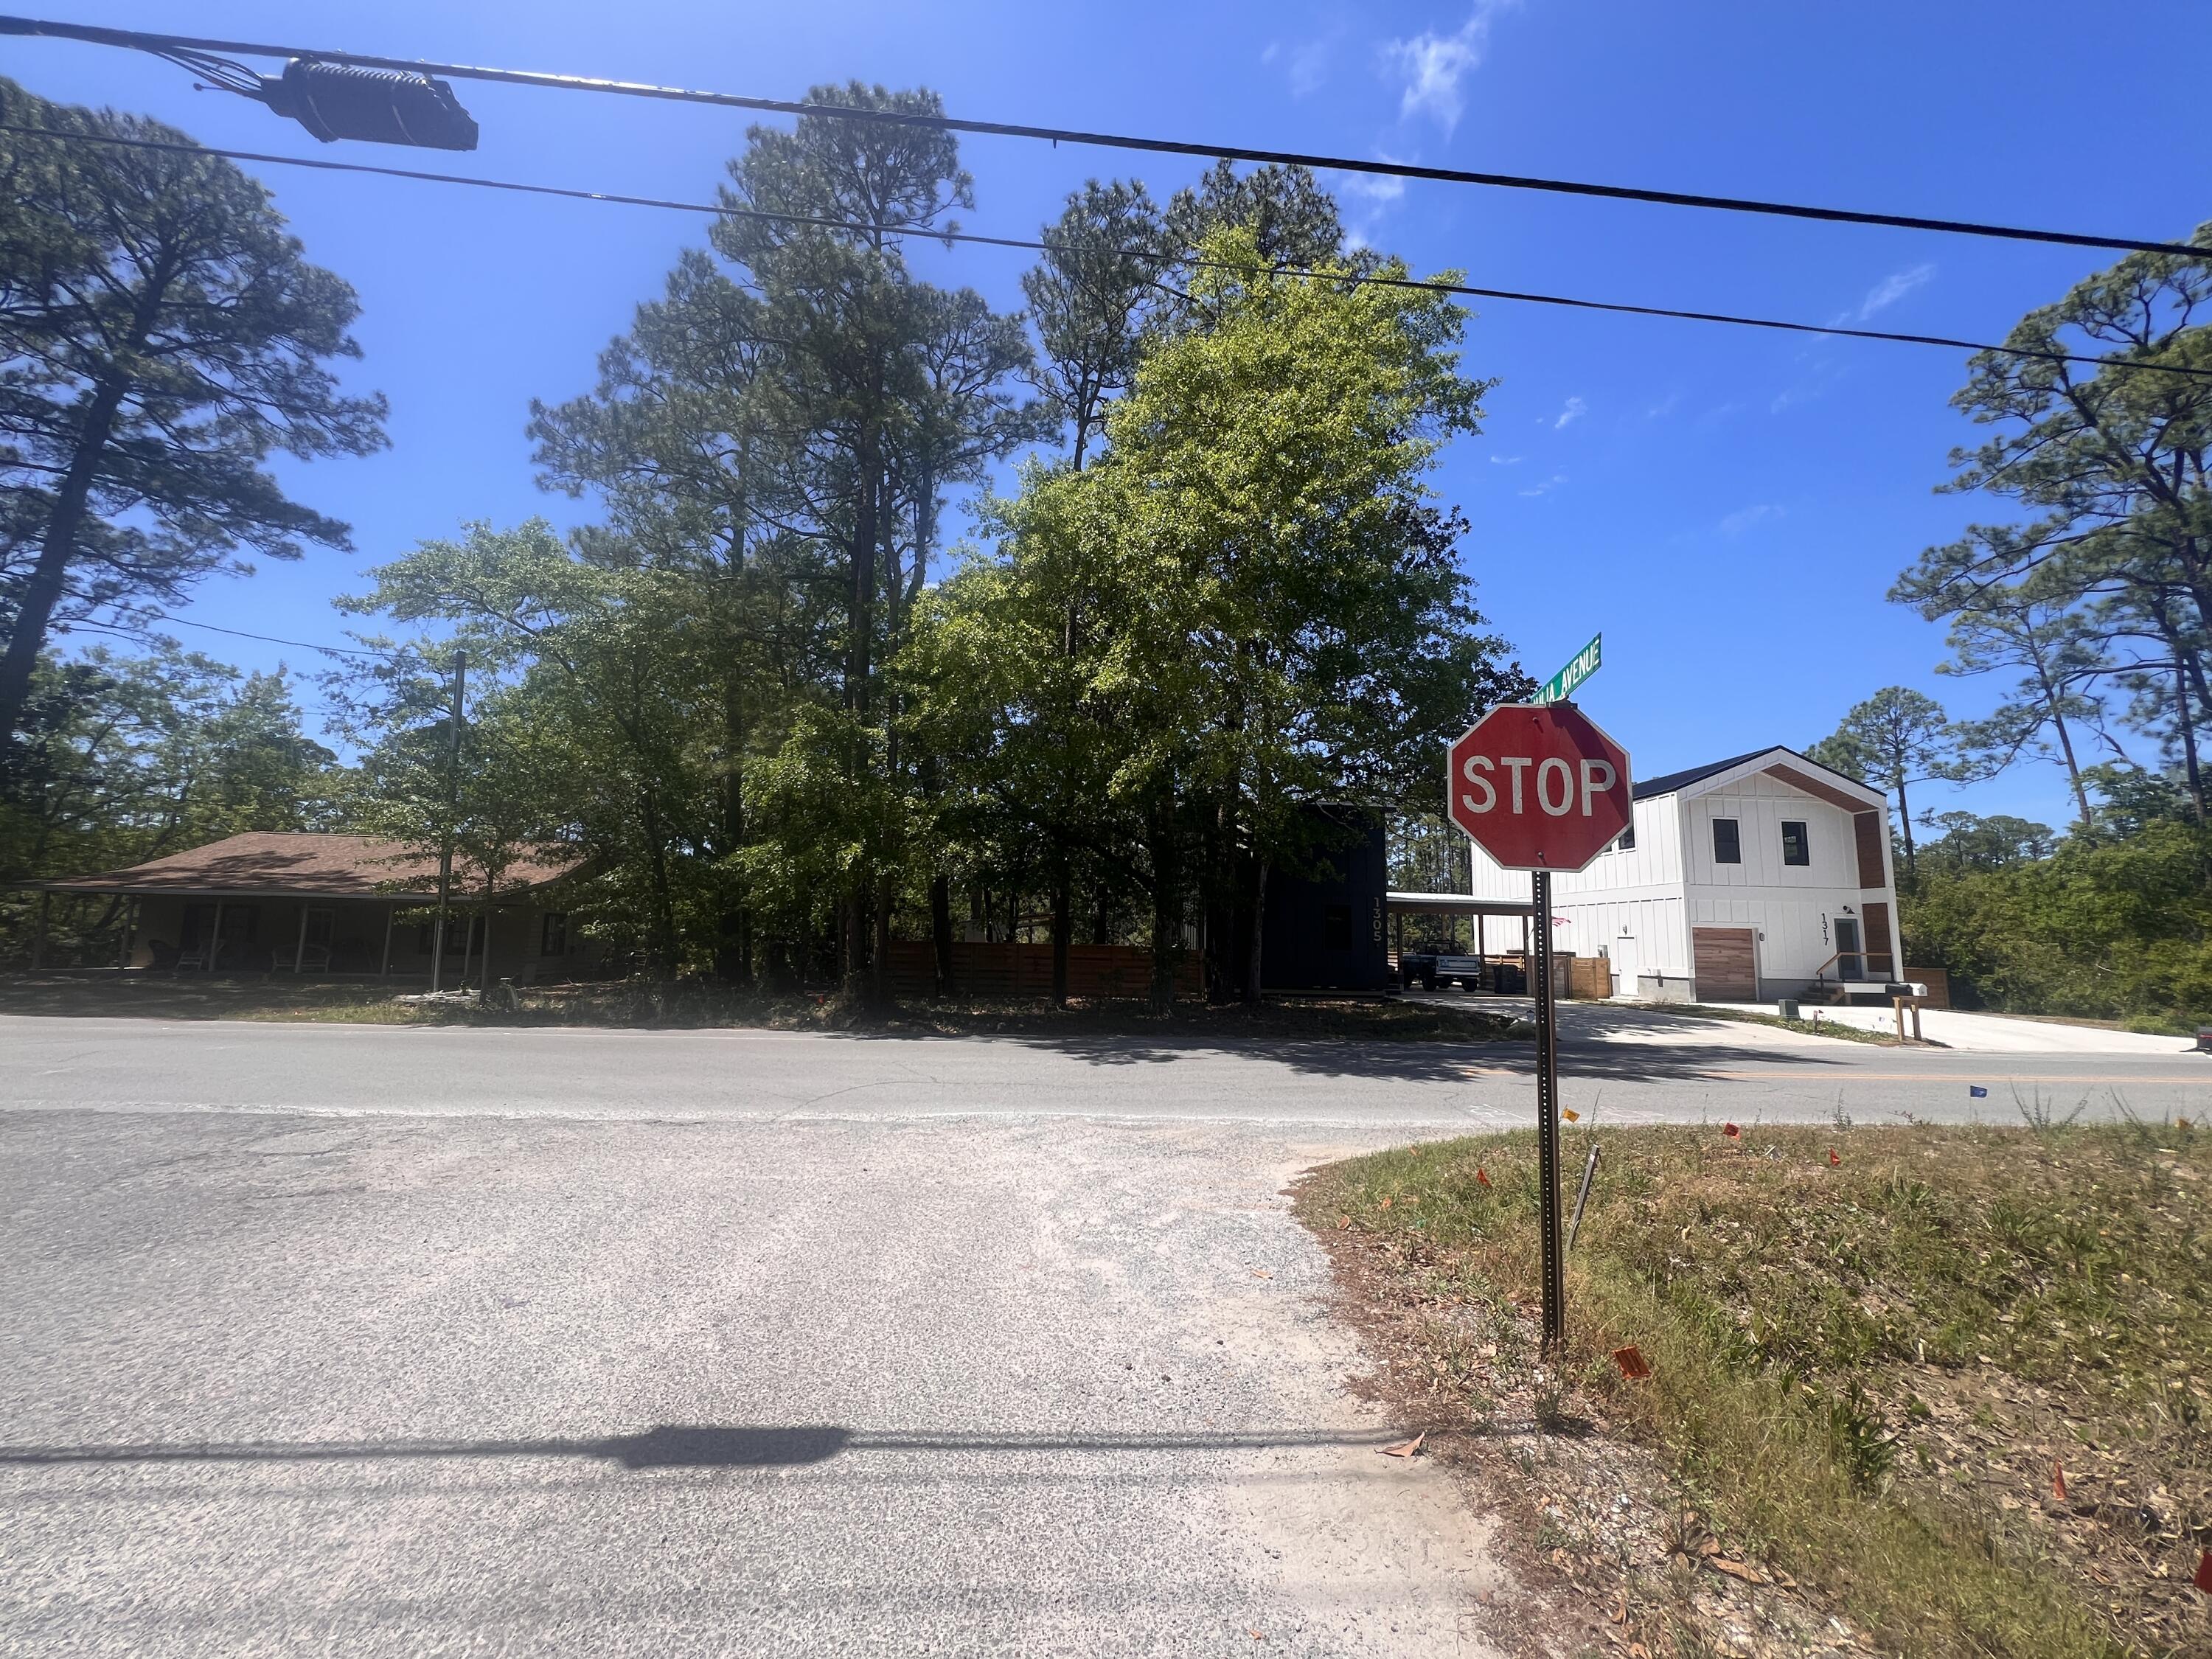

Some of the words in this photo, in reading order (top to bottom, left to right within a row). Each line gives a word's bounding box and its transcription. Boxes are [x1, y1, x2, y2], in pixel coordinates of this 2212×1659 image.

[1561, 639, 1599, 695] AVENUE
[1462, 755, 1616, 817] STOP
[1373, 897, 1382, 942] 1305
